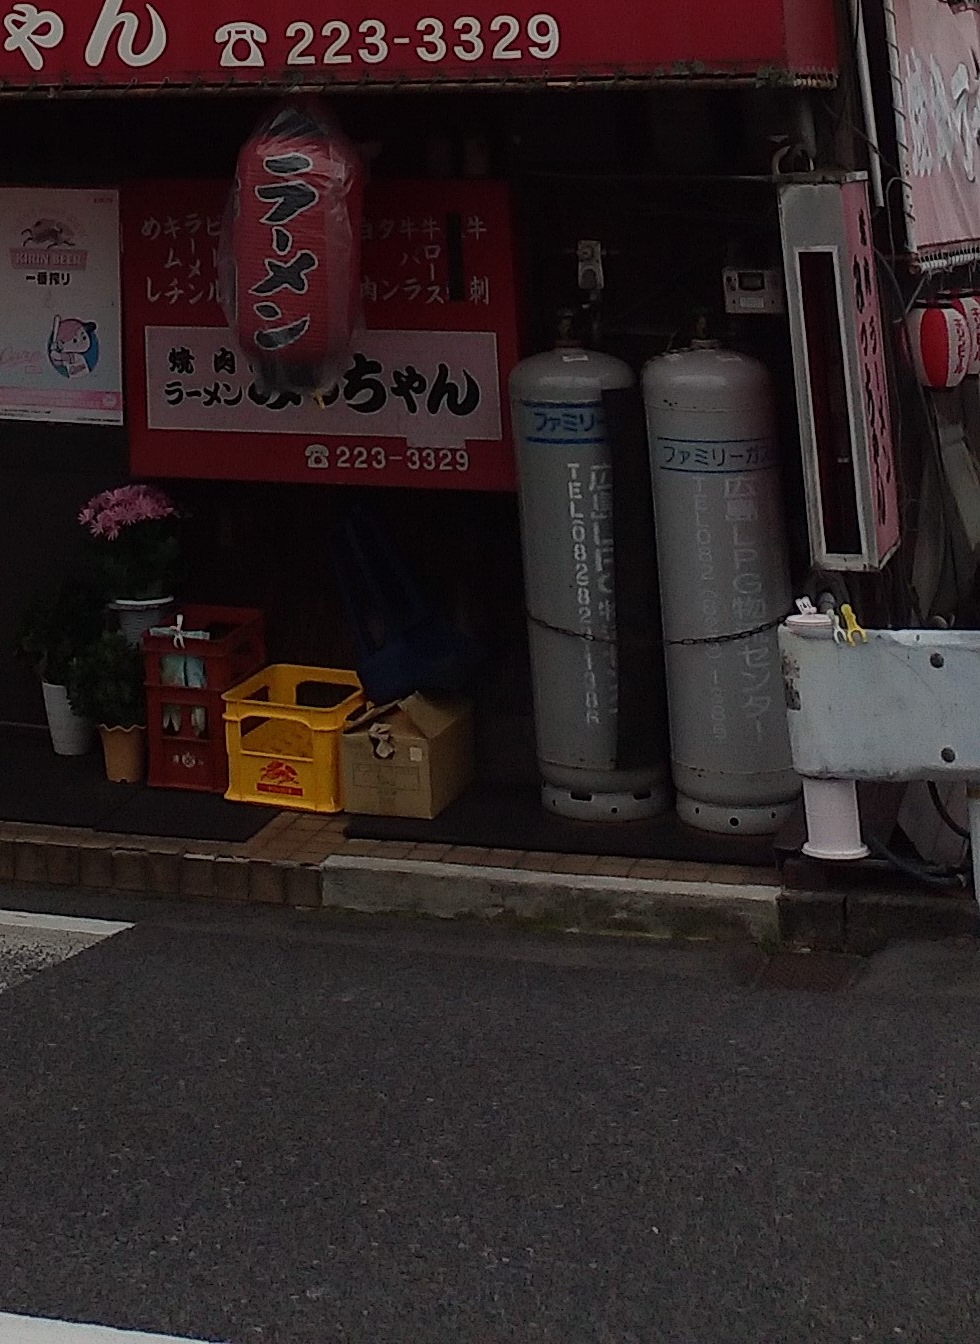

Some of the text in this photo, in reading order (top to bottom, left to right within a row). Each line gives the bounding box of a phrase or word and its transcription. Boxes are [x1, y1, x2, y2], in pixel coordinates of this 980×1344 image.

[286, 13, 560, 65] 223-3329
[52, 253, 83, 265] BEER
[141, 216, 161, 303] めし
[163, 216, 184, 305] キムチ
[184, 213, 205, 305] ラーメン
[249, 154, 319, 350] ラーメン
[379, 217, 400, 301] タン
[420, 214, 445, 304] 牛ロース
[467, 214, 490, 305] 牛刺
[165, 380, 243, 407] ラーメン
[168, 346, 236, 375] 焼肉
[335, 445, 471, 473] 223-3329
[662, 445, 773, 468] ファミリーガス
